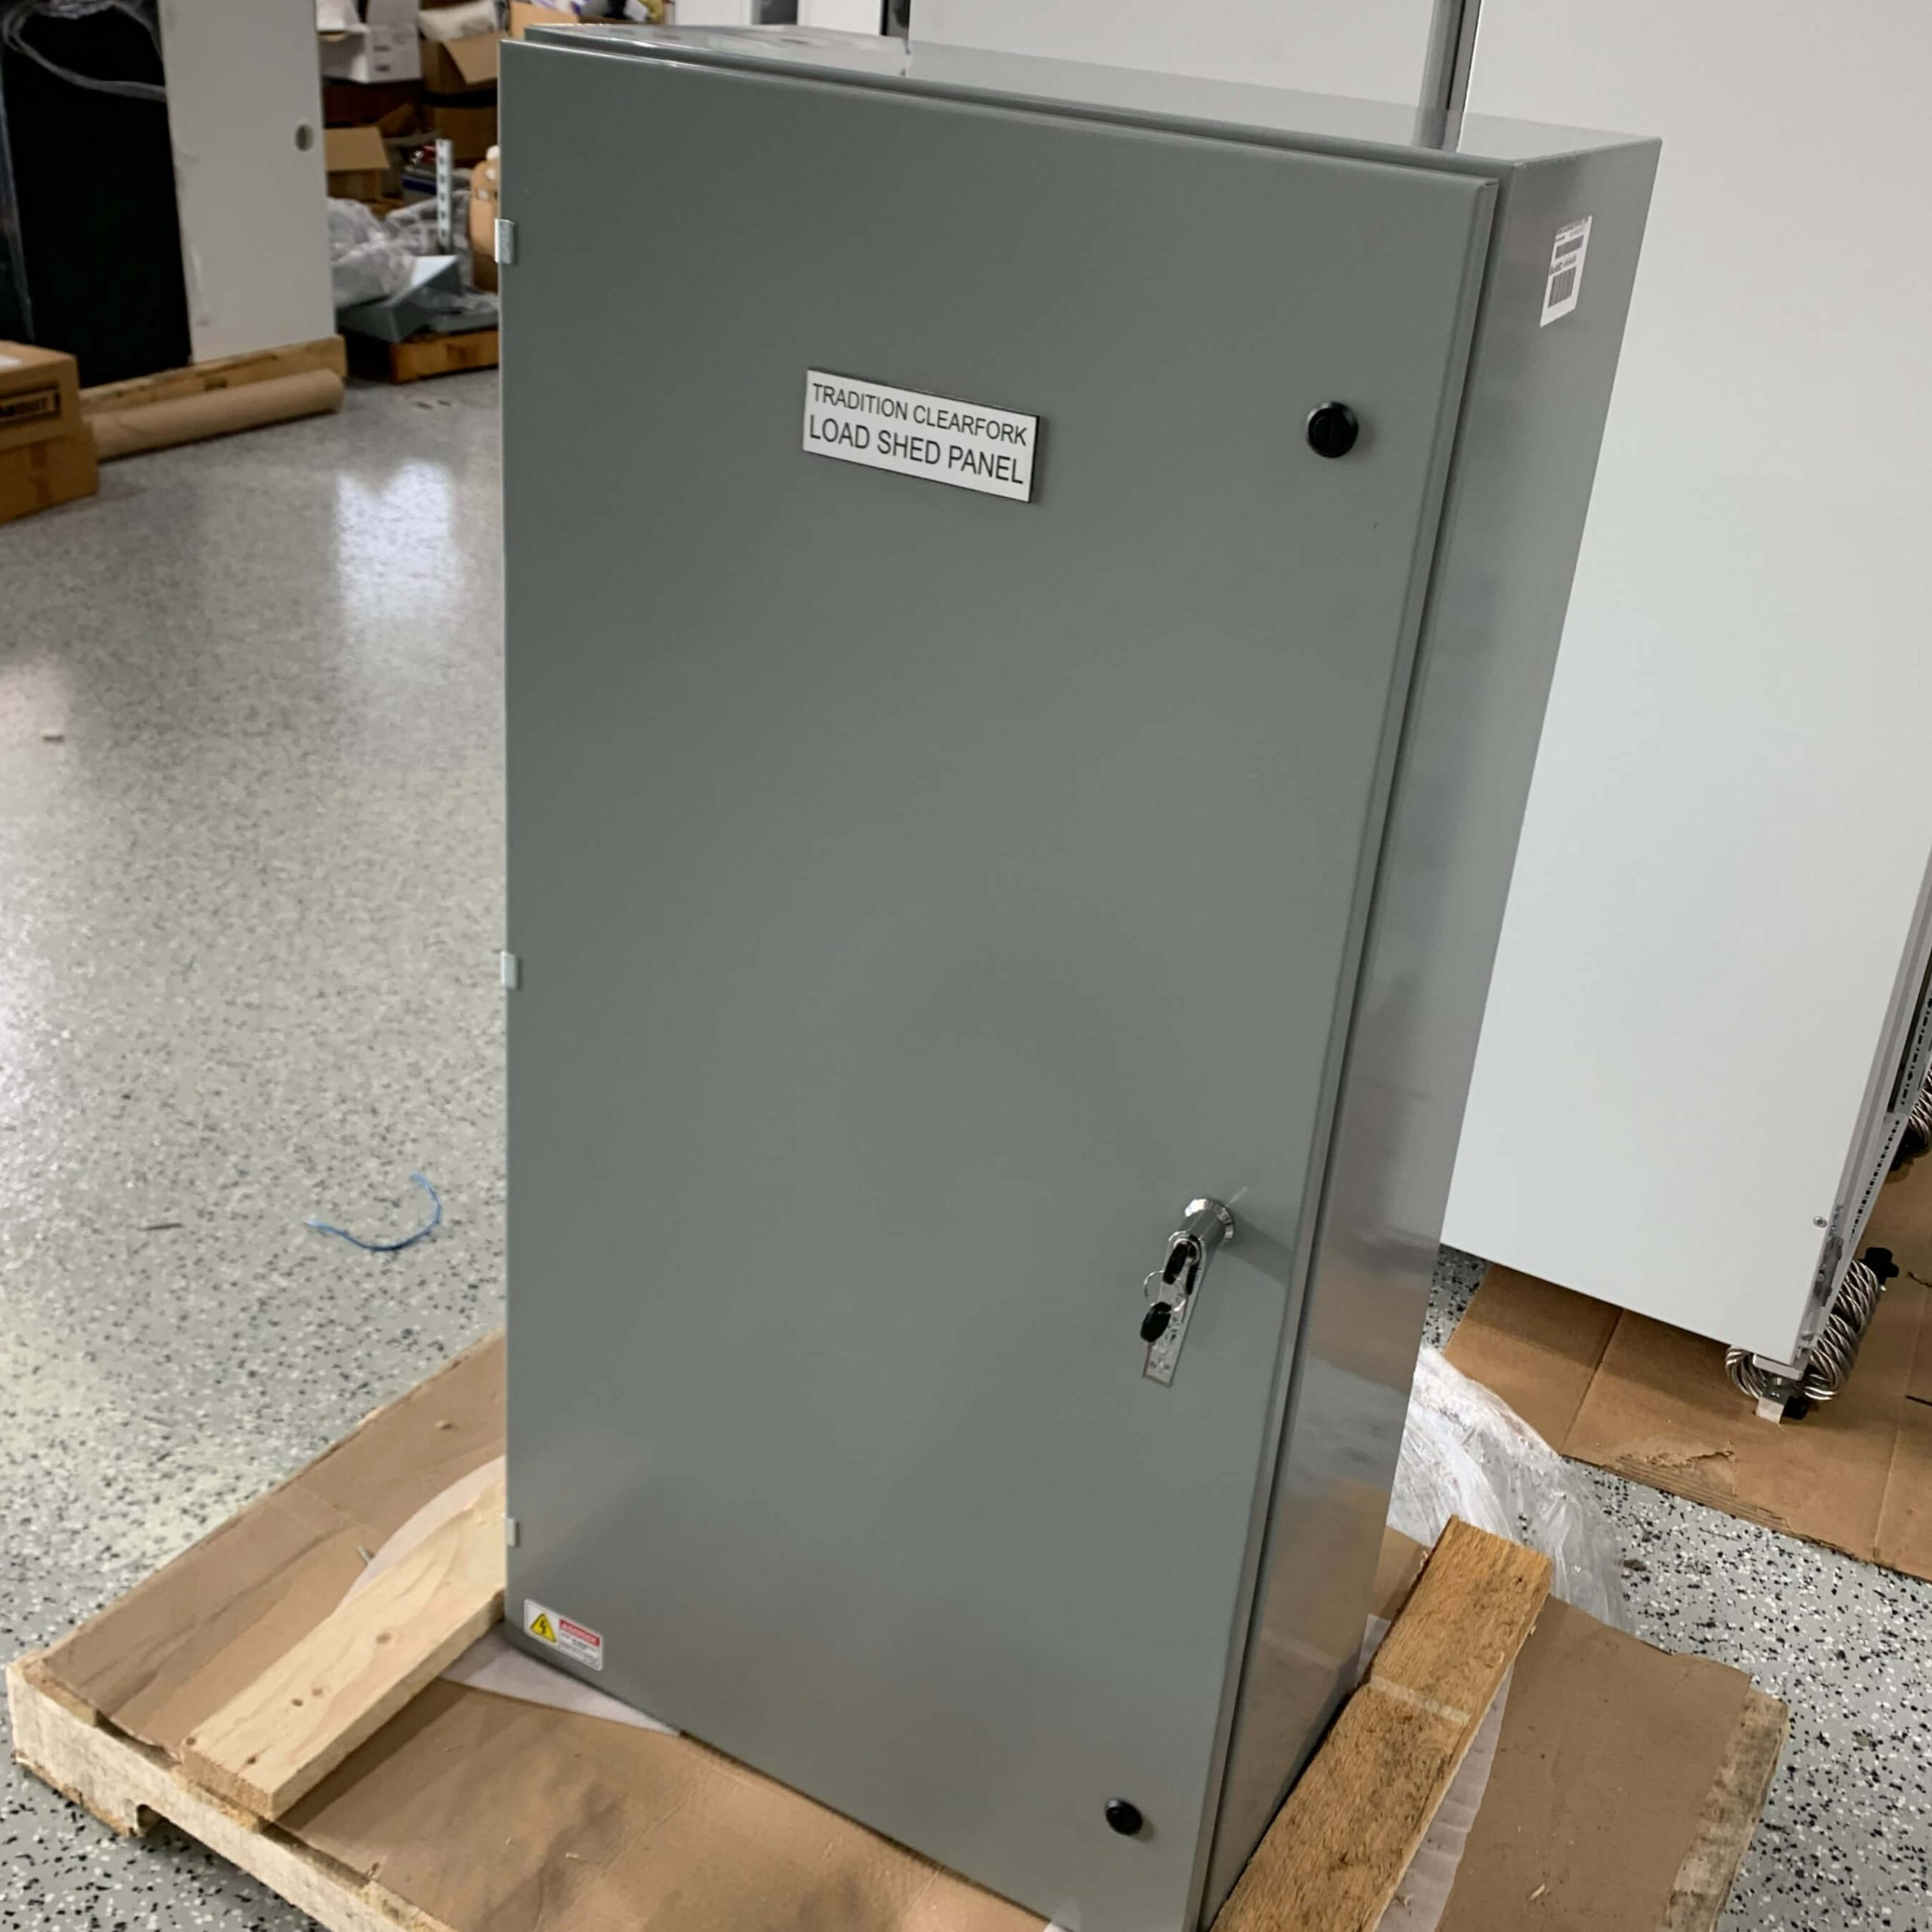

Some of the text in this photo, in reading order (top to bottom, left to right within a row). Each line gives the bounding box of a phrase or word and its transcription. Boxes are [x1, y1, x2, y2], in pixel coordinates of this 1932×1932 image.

[813, 383, 1027, 446] TRADITION CLEARFORK
[810, 414, 1023, 485] LOAD SHED PANEL
